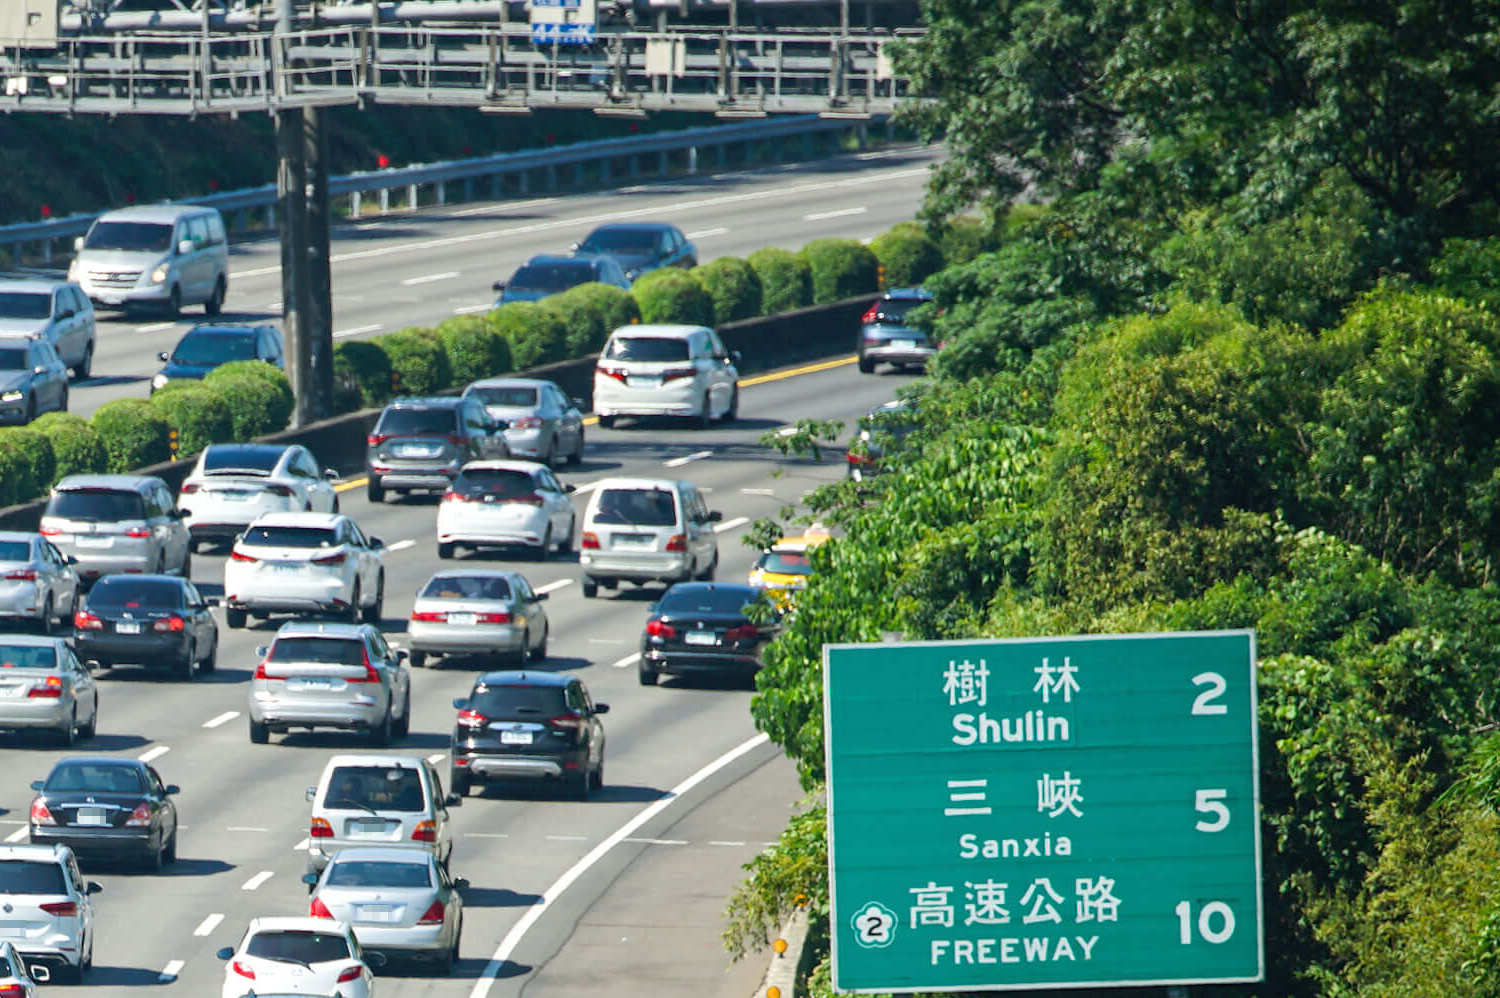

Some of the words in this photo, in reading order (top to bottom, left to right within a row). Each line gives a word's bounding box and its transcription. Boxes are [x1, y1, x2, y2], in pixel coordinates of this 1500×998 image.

[1191, 672, 1227, 715] 2
[952, 711, 1069, 746] Shulin
[1195, 789, 1230, 833] 5
[960, 833, 1071, 859] Sanxia
[909, 876, 1122, 929] 高速公路
[867, 917, 883, 937] 2
[1175, 900, 1235, 945] 10
[931, 936, 1099, 965] FREEWAY
